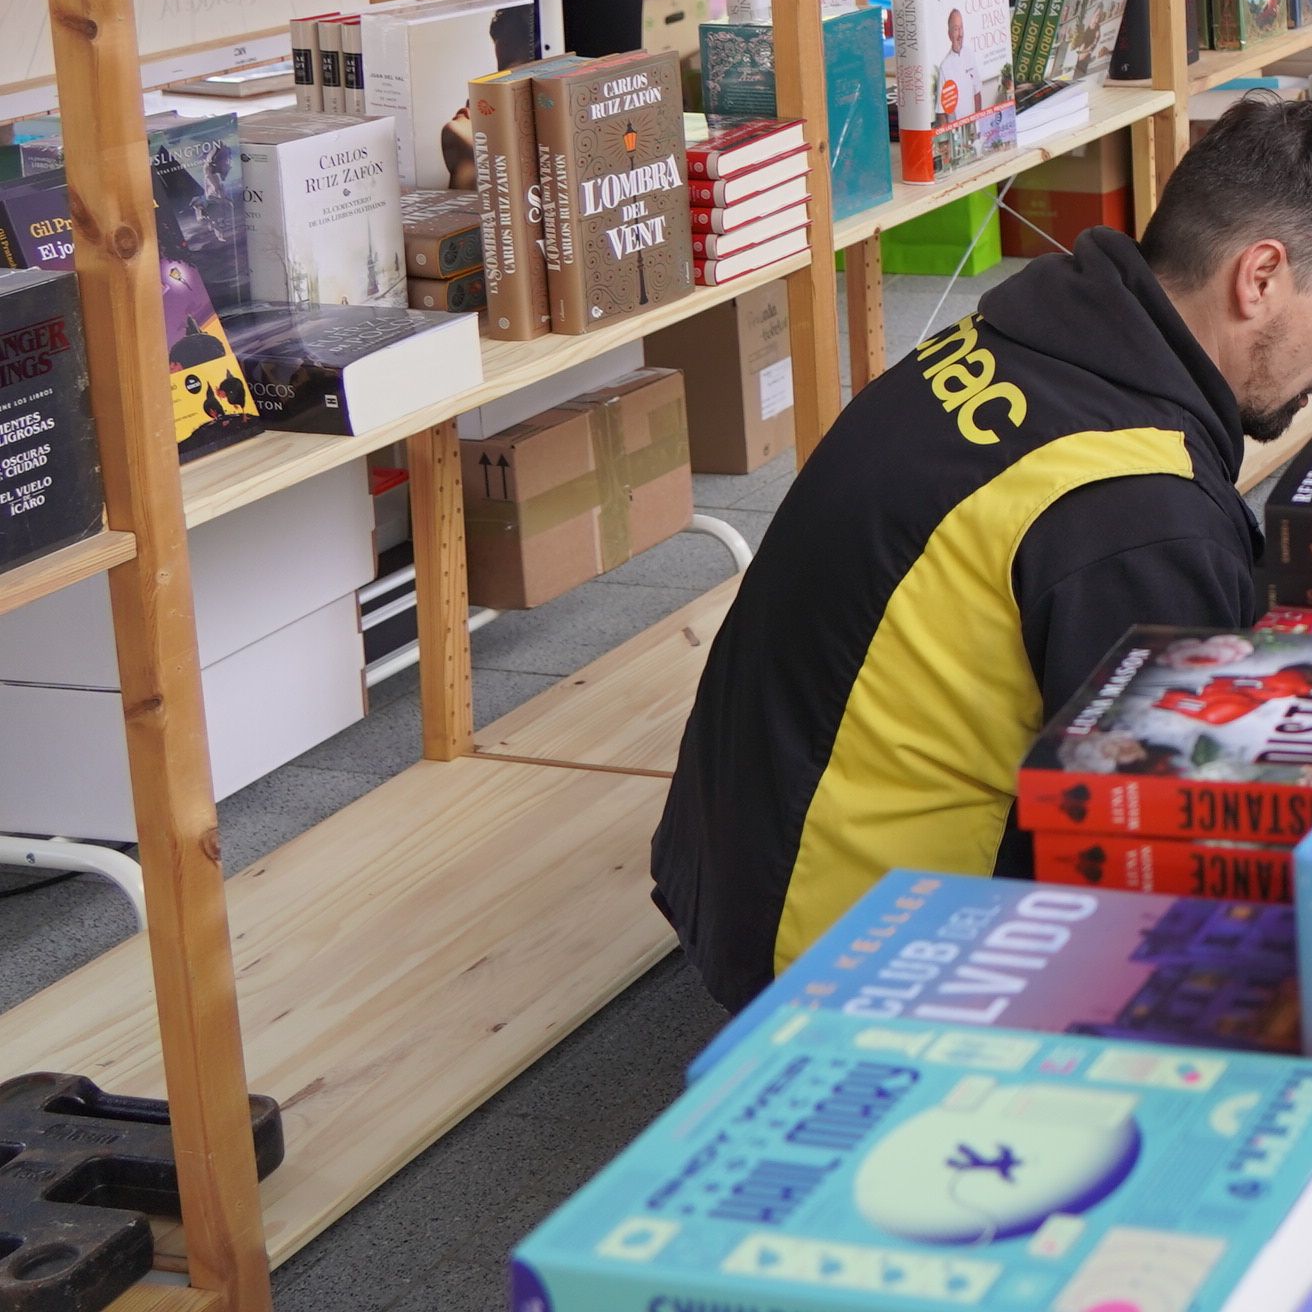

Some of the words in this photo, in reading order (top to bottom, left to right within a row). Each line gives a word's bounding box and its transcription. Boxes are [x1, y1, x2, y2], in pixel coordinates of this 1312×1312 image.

[981, 10, 1006, 28] PARA
[970, 29, 1008, 52] TODOS
[1023, 20, 1040, 56] JORDI
[1039, 21, 1056, 57] JORDI
[603, 72, 649, 98] CARLOS
[590, 98, 621, 121] RUIZ
[623, 84, 662, 110] ZAFÓN
[319, 147, 368, 170] CARLOS
[475, 131, 494, 191] VIENTO
[494, 154, 510, 193] ZAFÓN
[538, 143, 553, 188] VENT
[554, 153, 569, 193] ZAFÓN
[305, 172, 339, 194] RUIZ
[342, 160, 385, 184] ZAFÓN
[581, 153, 684, 217] L'OMBRA
[497, 196, 512, 226] RUIZ
[557, 196, 572, 225] RUIZ
[622, 201, 648, 223] DEL
[30, 220, 54, 239] Gil
[480, 209, 503, 282] SOMBRA
[561, 226, 575, 265] CARLOS
[606, 215, 666, 260] VENT
[38, 243, 57, 261] El
[501, 229, 517, 275] CARLOS
[14, 395, 28, 407] LOS
[1, 443, 52, 469] OSCURAS
[5, 454, 48, 479] CIUDAD
[0, 491, 14, 505] EL
[15, 475, 53, 499] VUELO
[9, 495, 46, 517] ÍCARO
[1067, 694, 1106, 736] LUNA
[1103, 648, 1152, 701] MASON
[842, 938, 961, 1020] CLUB
